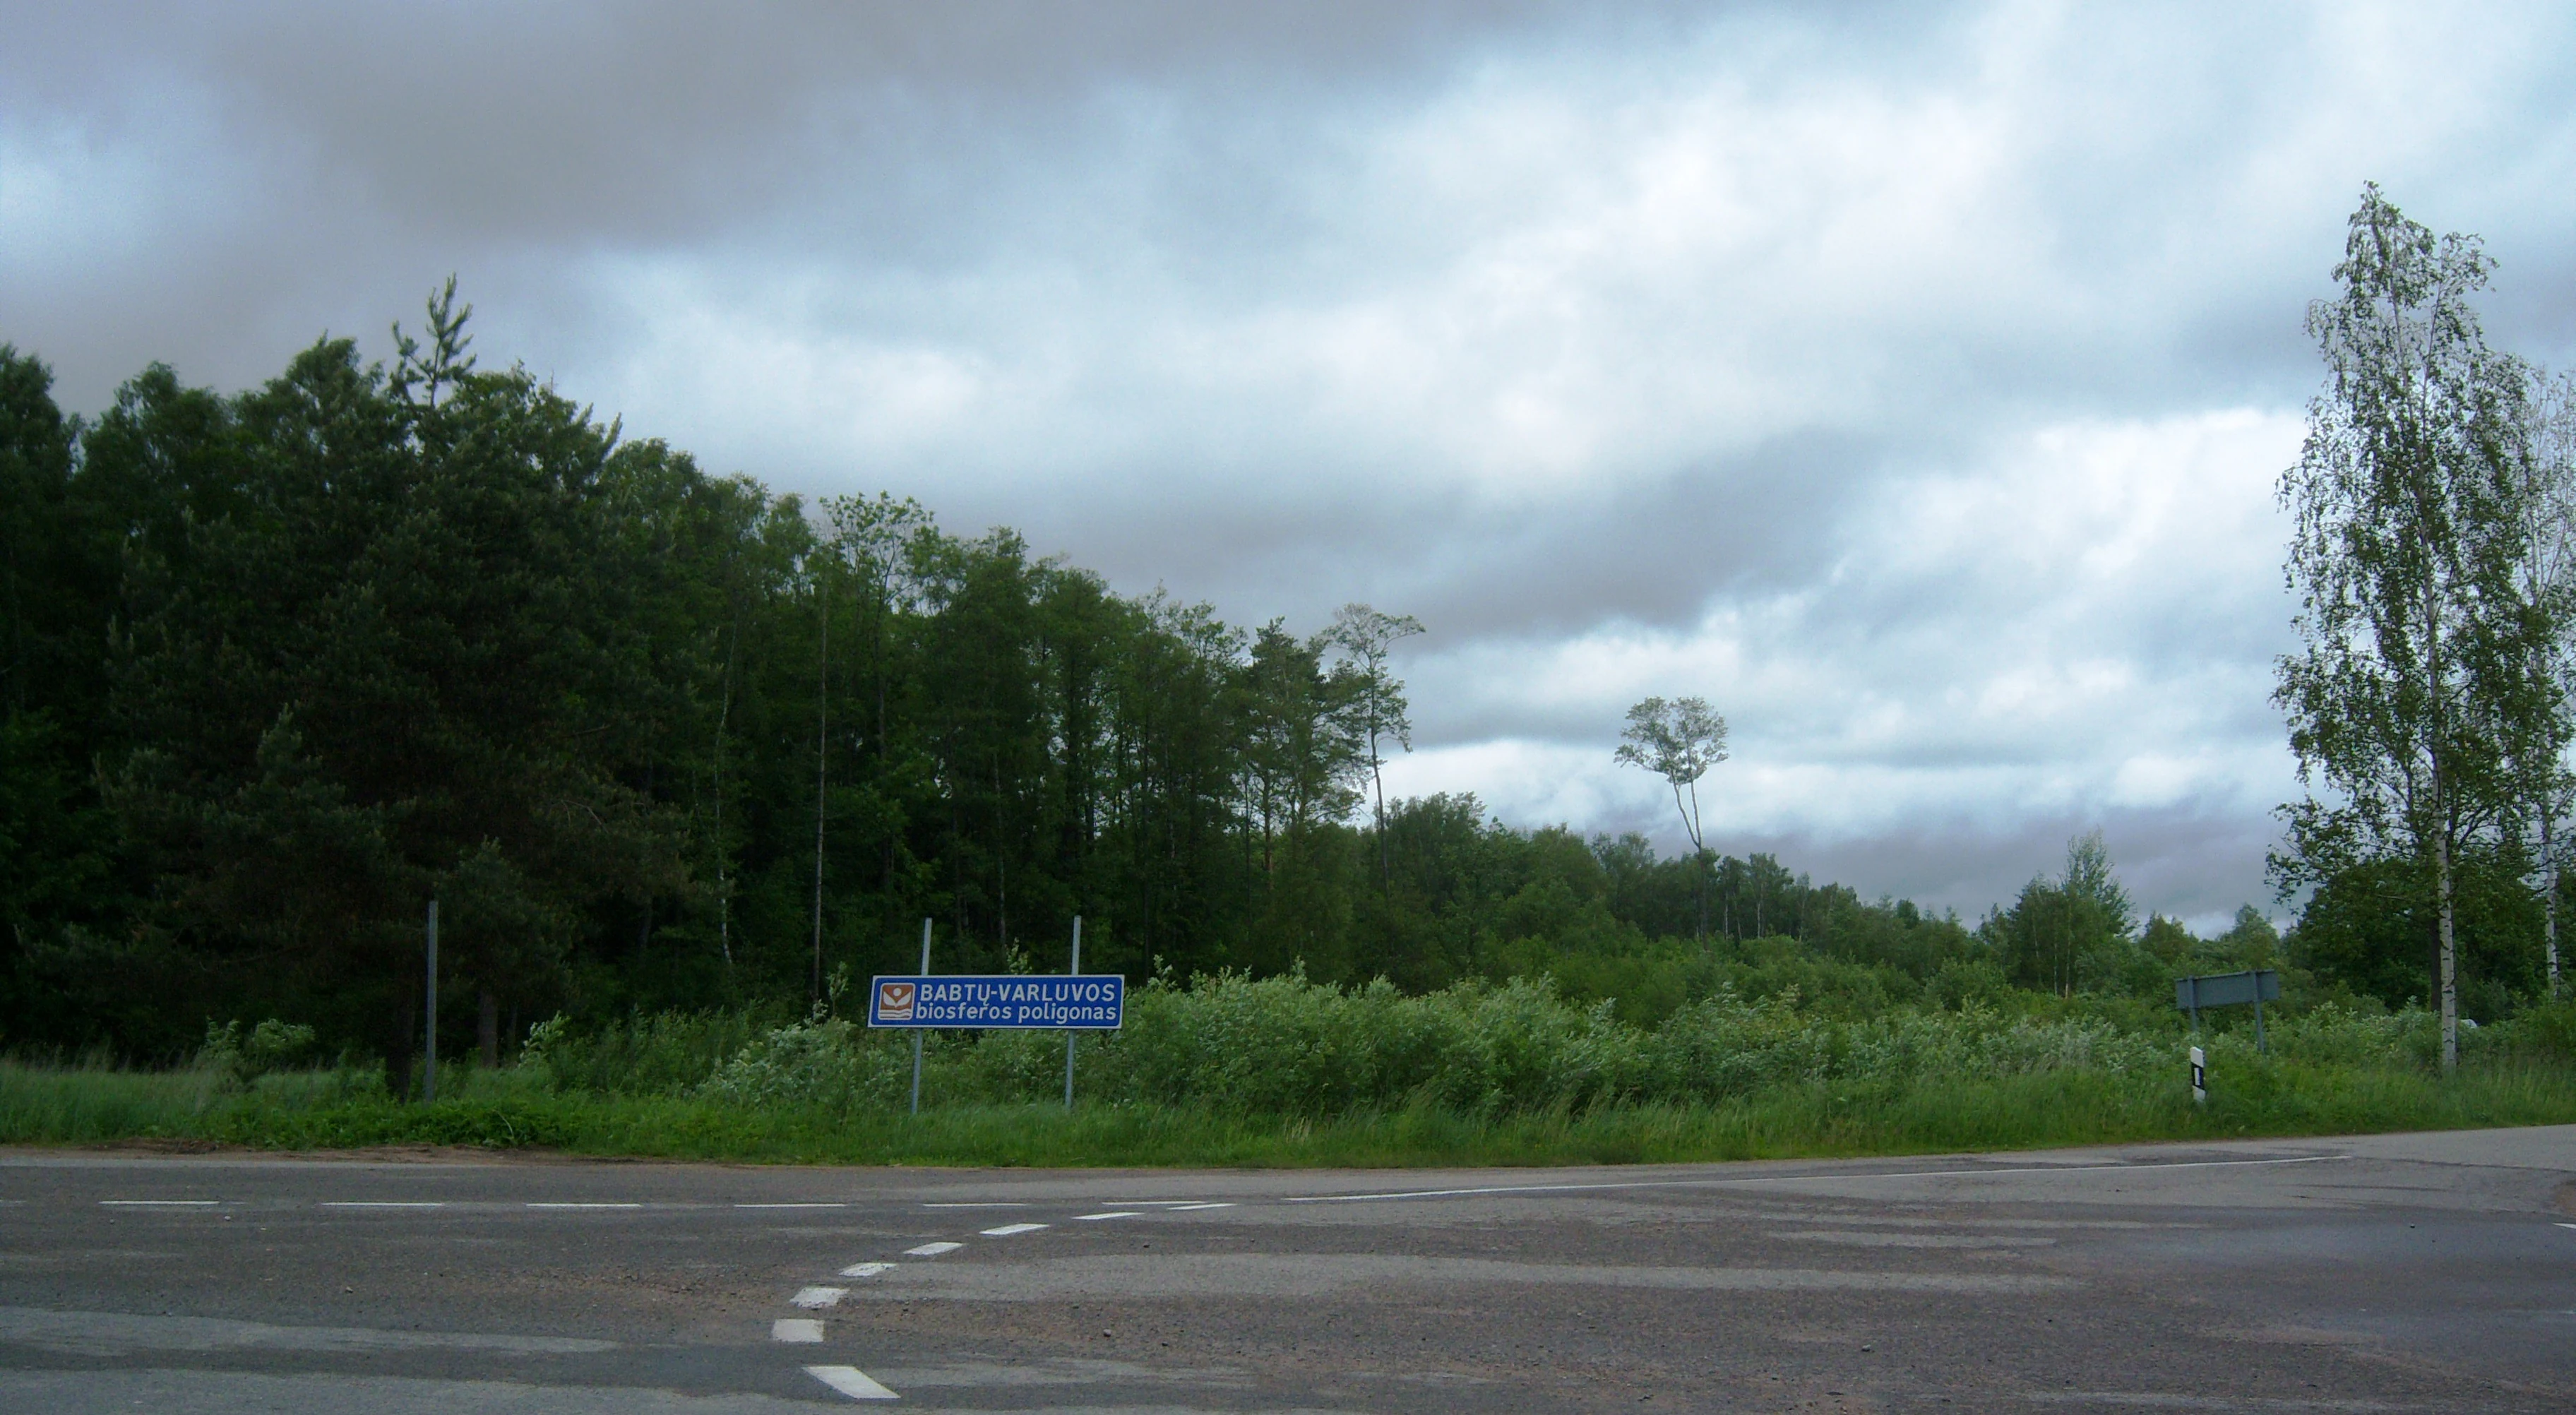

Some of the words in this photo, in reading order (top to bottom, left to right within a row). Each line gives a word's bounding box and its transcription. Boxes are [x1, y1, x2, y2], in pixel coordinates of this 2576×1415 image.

[920, 984, 1115, 1006] BABTŲ-VARLUVOS
[916, 1002, 1012, 1020] biosferos
[1018, 1002, 1117, 1025] poligonas
